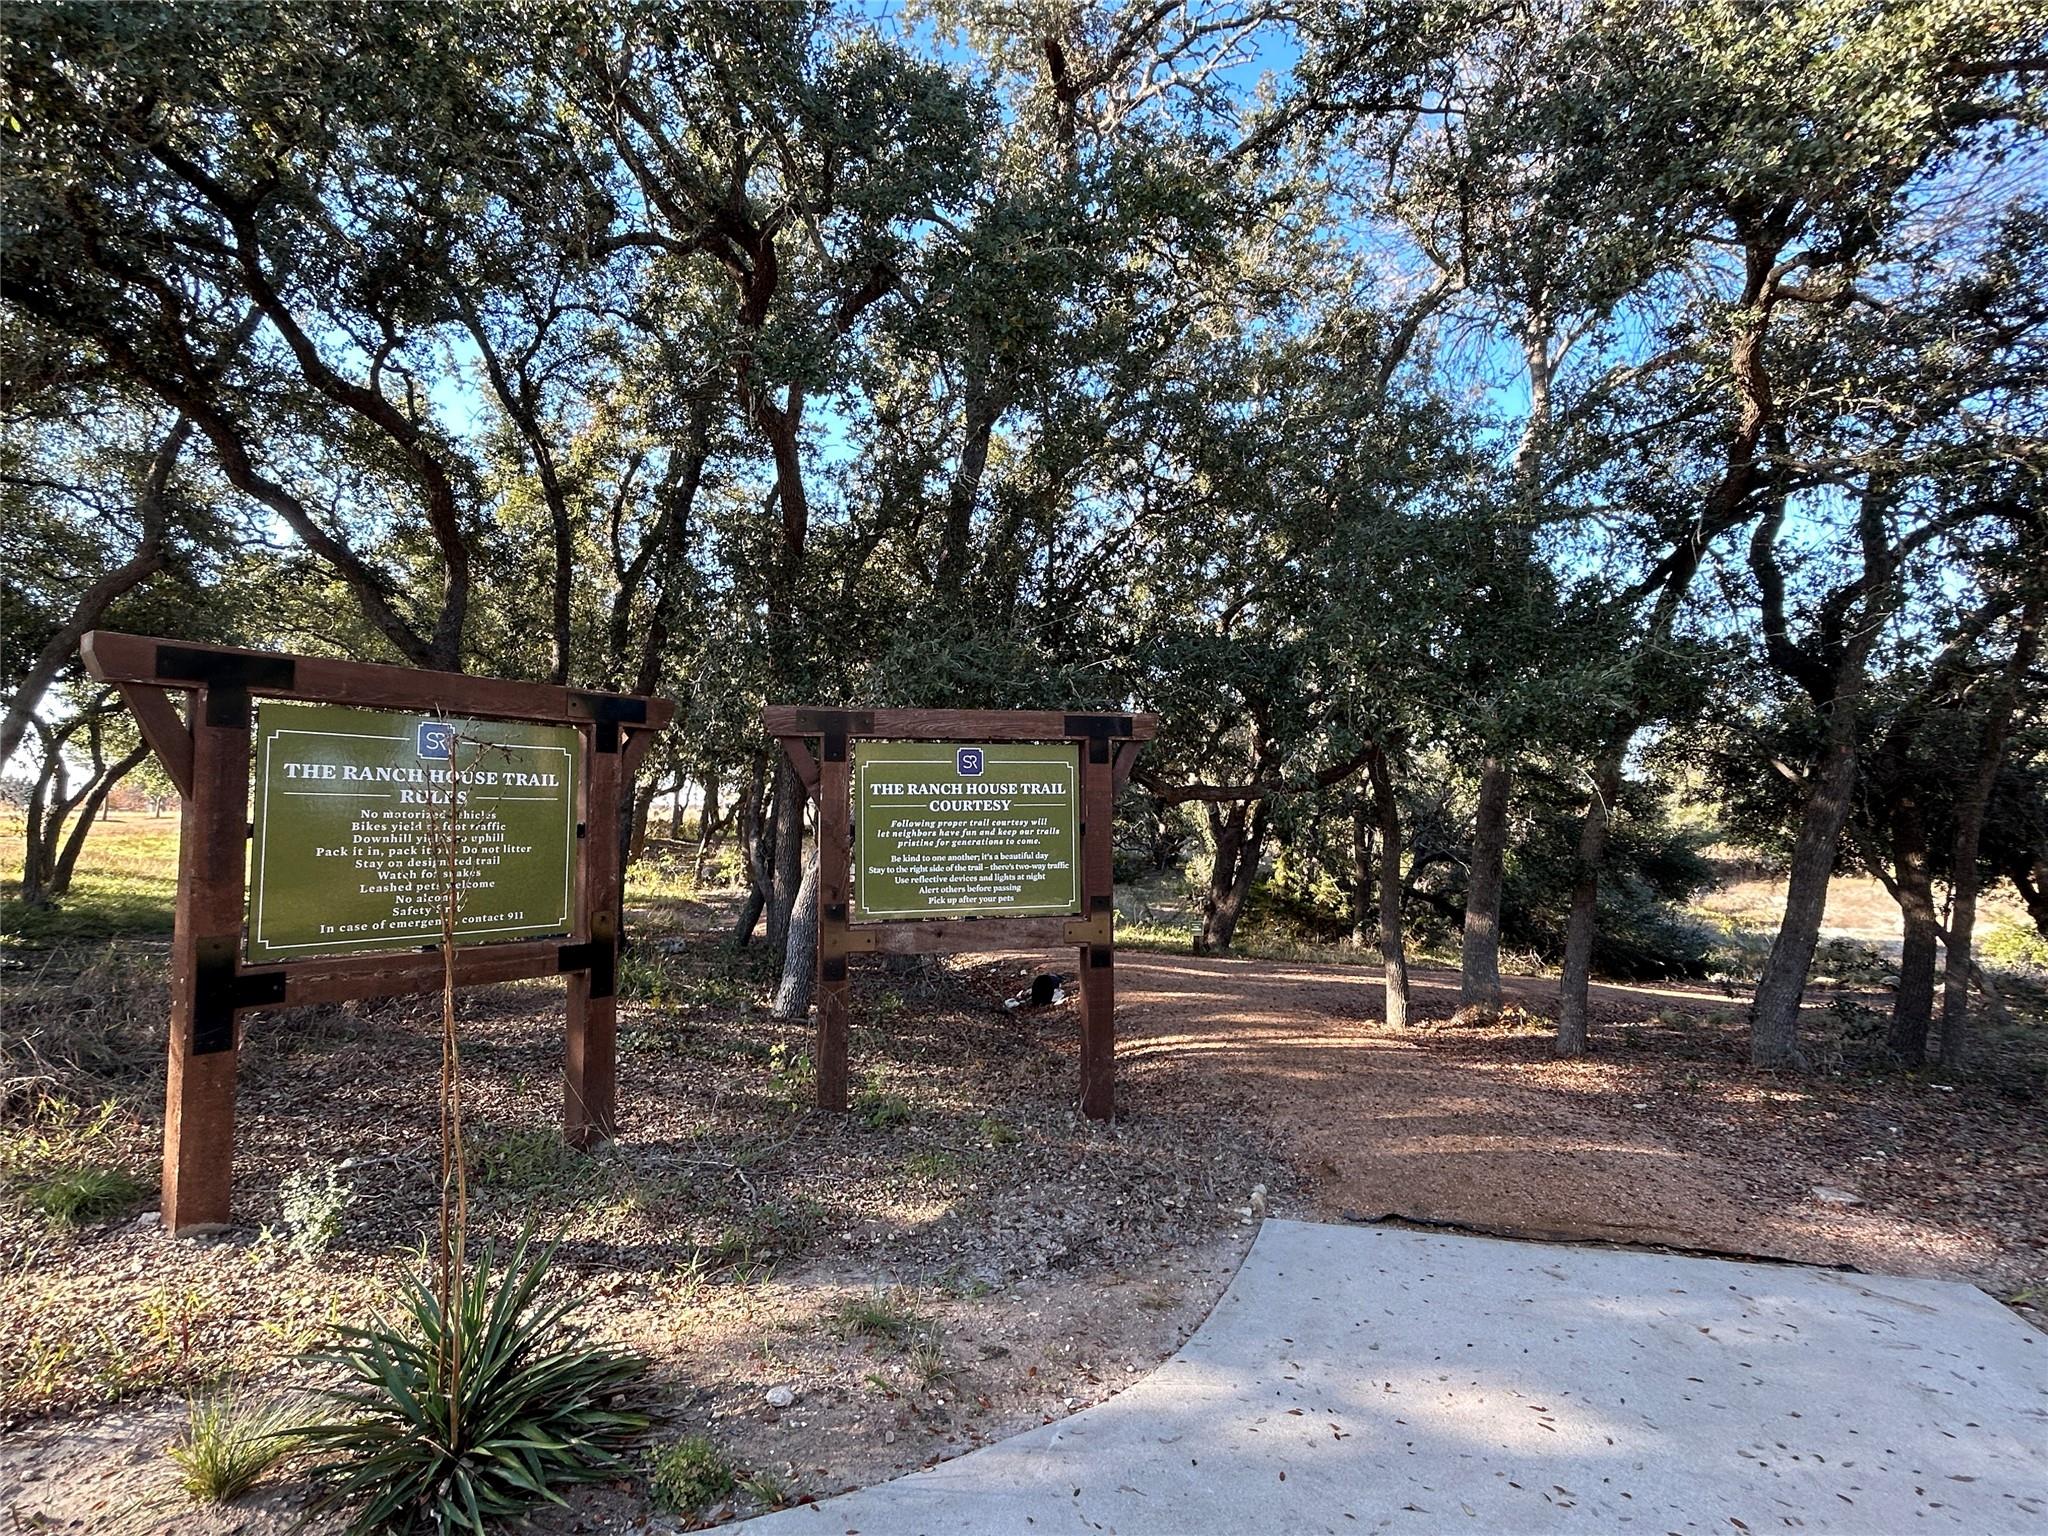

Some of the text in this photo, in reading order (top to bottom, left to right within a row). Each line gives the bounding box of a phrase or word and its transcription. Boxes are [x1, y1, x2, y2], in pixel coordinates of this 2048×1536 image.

[284, 763, 559, 787] THE RANCH HOUSE TRAIL
[870, 783, 1066, 795] THE RANCH HOUSE TRAIL
[929, 800, 1012, 812] COURTESY
[361, 809, 378, 819] No
[450, 810, 497, 820] ehicles
[352, 822, 387, 831] Bikes
[391, 822, 422, 833] yield
[443, 822, 466, 831] foot
[471, 821, 506, 831] traffic
[891, 818, 1048, 828] Following proper trail courtesy will
[877, 830, 890, 838] let
[892, 829, 937, 838] neighbors
[939, 829, 960, 837] have
[961, 828, 977, 838] fun
[979, 828, 995, 836] and
[998, 827, 1017, 837] keep
[1037, 827, 1060, 835] trails
[353, 833, 412, 846] Downhill
[471, 833, 504, 844] uphill
[897, 839, 934, 848] pristine
[934, 838, 949, 848] for
[951, 838, 1004, 848] generations
[316, 847, 348, 857] Pack
[353, 846, 363, 856] it
[368, 846, 384, 857] in,
[389, 846, 417, 858] pack
[422, 846, 431, 855] it
[463, 845, 478, 854] Do
[482, 845, 500, 854] not
[503, 844, 532, 853] litter
[903, 854, 920, 862] kind
[1000, 852, 1034, 860] beautiful
[1035, 852, 1049, 861] day
[355, 857, 500, 870] Stay on desinted trail
[869, 866, 886, 875] Stay
[896, 865, 908, 873] the
[910, 865, 928, 874] right
[929, 864, 944, 872] side
[946, 864, 954, 872] of
[954, 864, 966, 872] the
[968, 863, 984, 871] trail
[990, 863, 1014, 871] there's
[1016, 863, 1046, 871] two-way
[1047, 861, 1070, 869] traffic
[378, 870, 417, 880] Watch
[911, 875, 948, 883] reflective
[949, 874, 977, 882] devices
[995, 873, 1016, 882] lights
[1026, 872, 1046, 882] night
[360, 881, 412, 893] Leashed
[919, 884, 1022, 894] Alert others before passing
[396, 895, 412, 904] No
[928, 896, 946, 904] Pick
[958, 895, 977, 903] after
[979, 896, 996, 904] your
[998, 895, 1014, 903] pets
[392, 905, 431, 917] Safety
[320, 924, 334, 934] In
[339, 924, 368, 932] case
[372, 920, 387, 930] of
[462, 914, 504, 924] contact
[507, 912, 524, 920] 911
